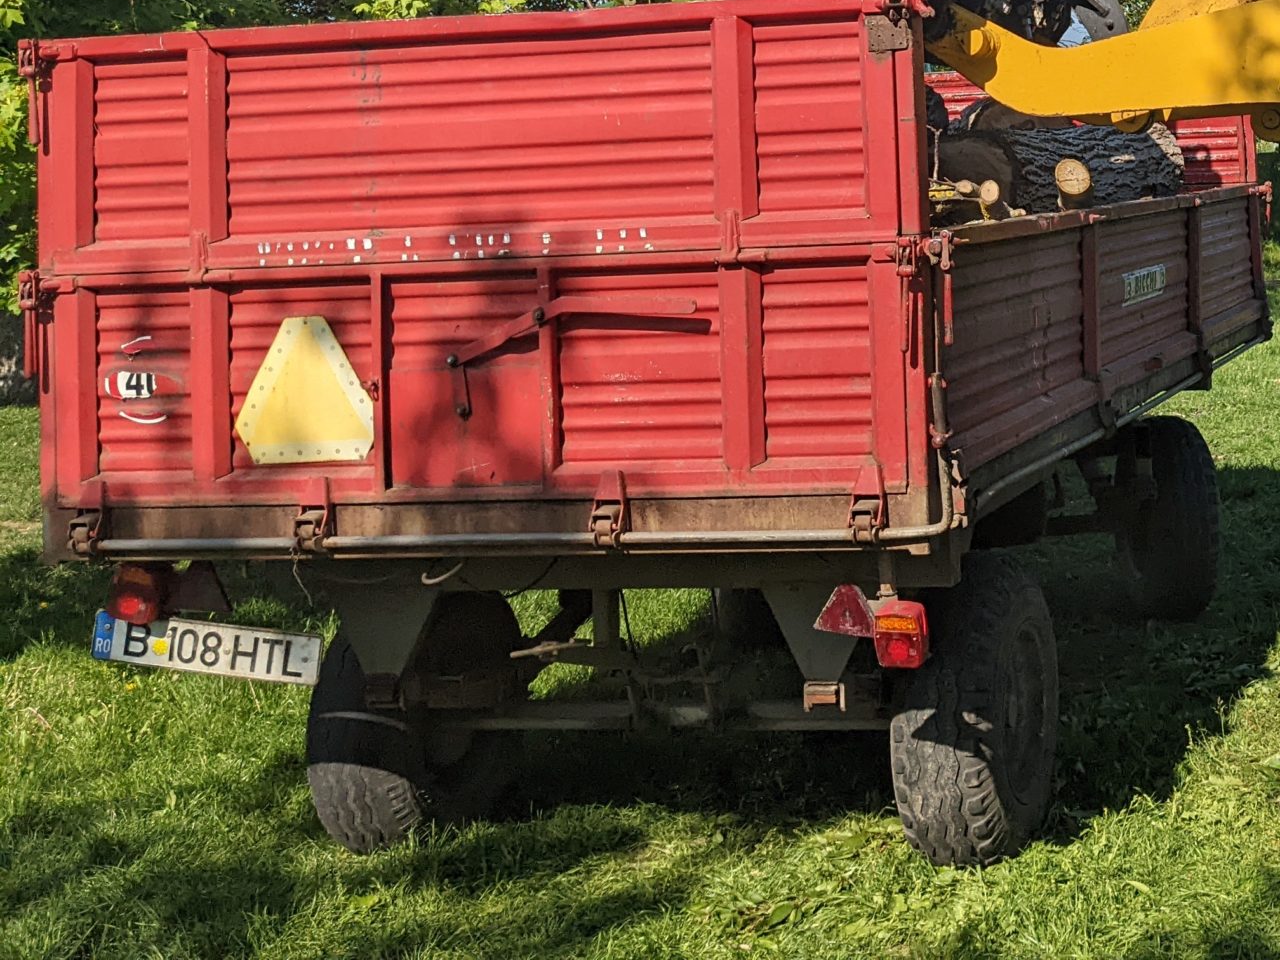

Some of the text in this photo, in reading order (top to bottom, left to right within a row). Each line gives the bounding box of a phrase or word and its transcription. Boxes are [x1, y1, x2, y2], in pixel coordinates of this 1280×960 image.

[94, 637, 111, 653] RO
[123, 622, 303, 678] B 108 HTL
